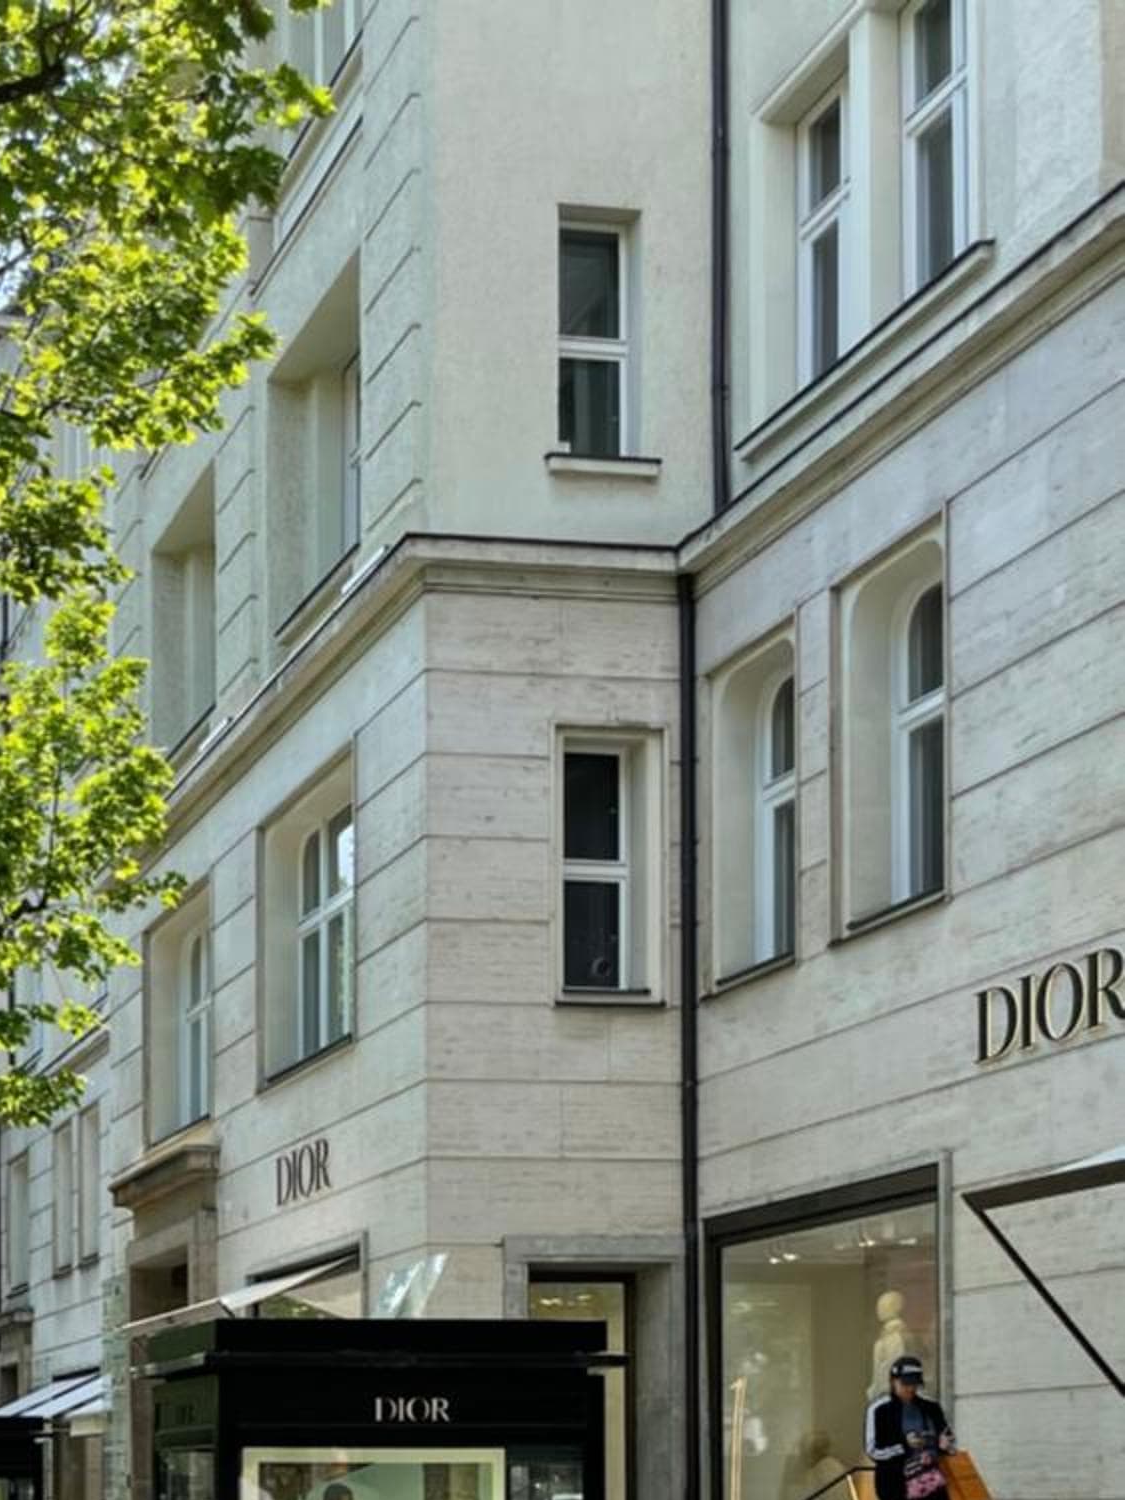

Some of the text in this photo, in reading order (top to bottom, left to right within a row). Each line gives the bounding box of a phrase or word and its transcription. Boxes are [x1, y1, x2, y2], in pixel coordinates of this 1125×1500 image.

[974, 948, 1125, 1064] DIOR
[276, 1139, 331, 1206] DIOR
[375, 1397, 450, 1422] DIOR
